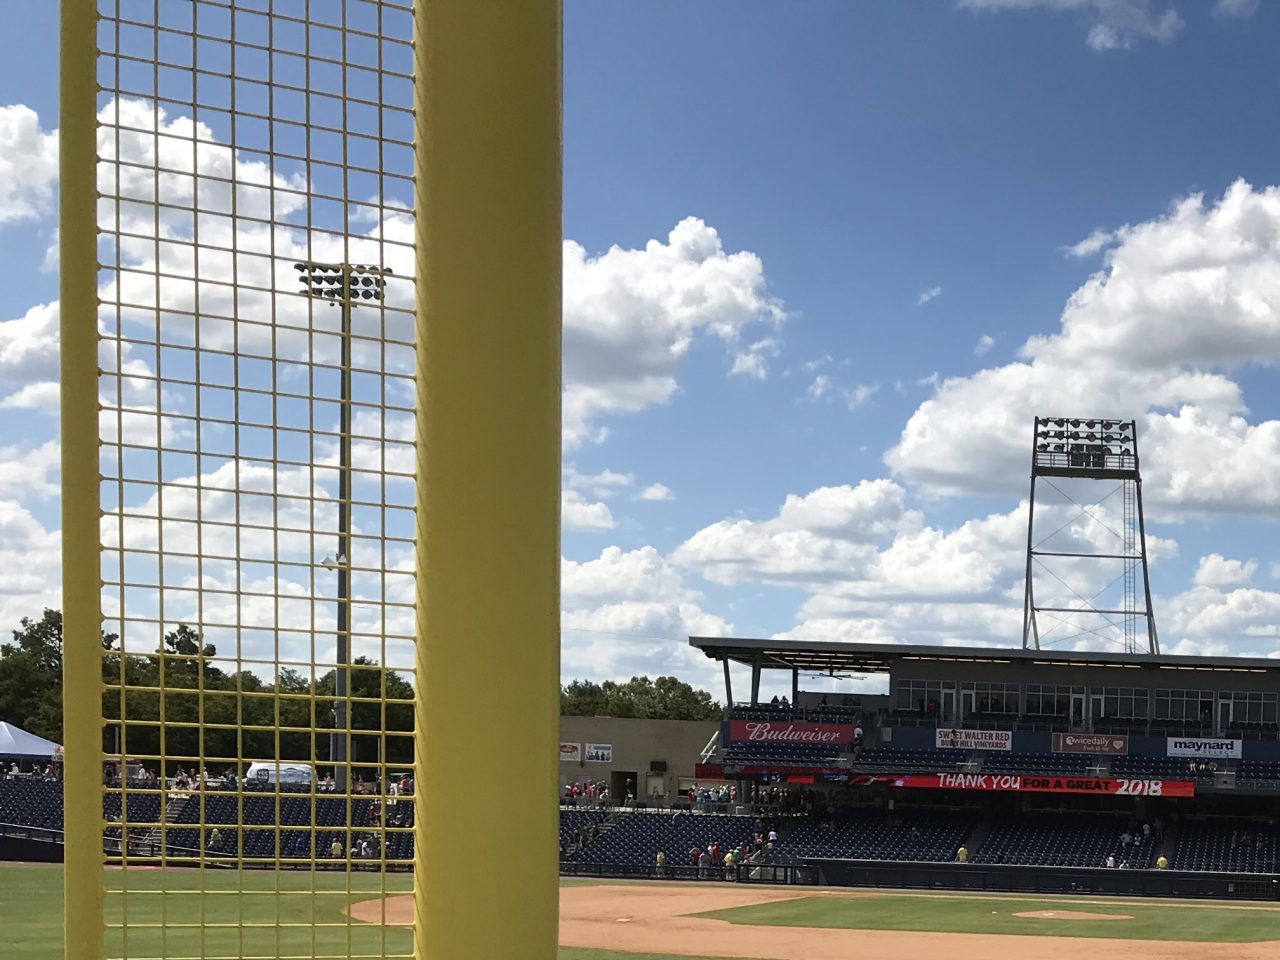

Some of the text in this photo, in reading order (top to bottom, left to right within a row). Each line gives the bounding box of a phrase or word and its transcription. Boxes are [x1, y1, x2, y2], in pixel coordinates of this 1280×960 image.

[745, 722, 841, 741] Budweiser
[938, 730, 1010, 741] SWET WALTER RED
[960, 740, 973, 748] HILL
[974, 741, 1007, 749] VINEYARDS
[1174, 741, 1234, 751] maynard
[937, 773, 1162, 796] THANK YOU FOR A GREAT 2018
